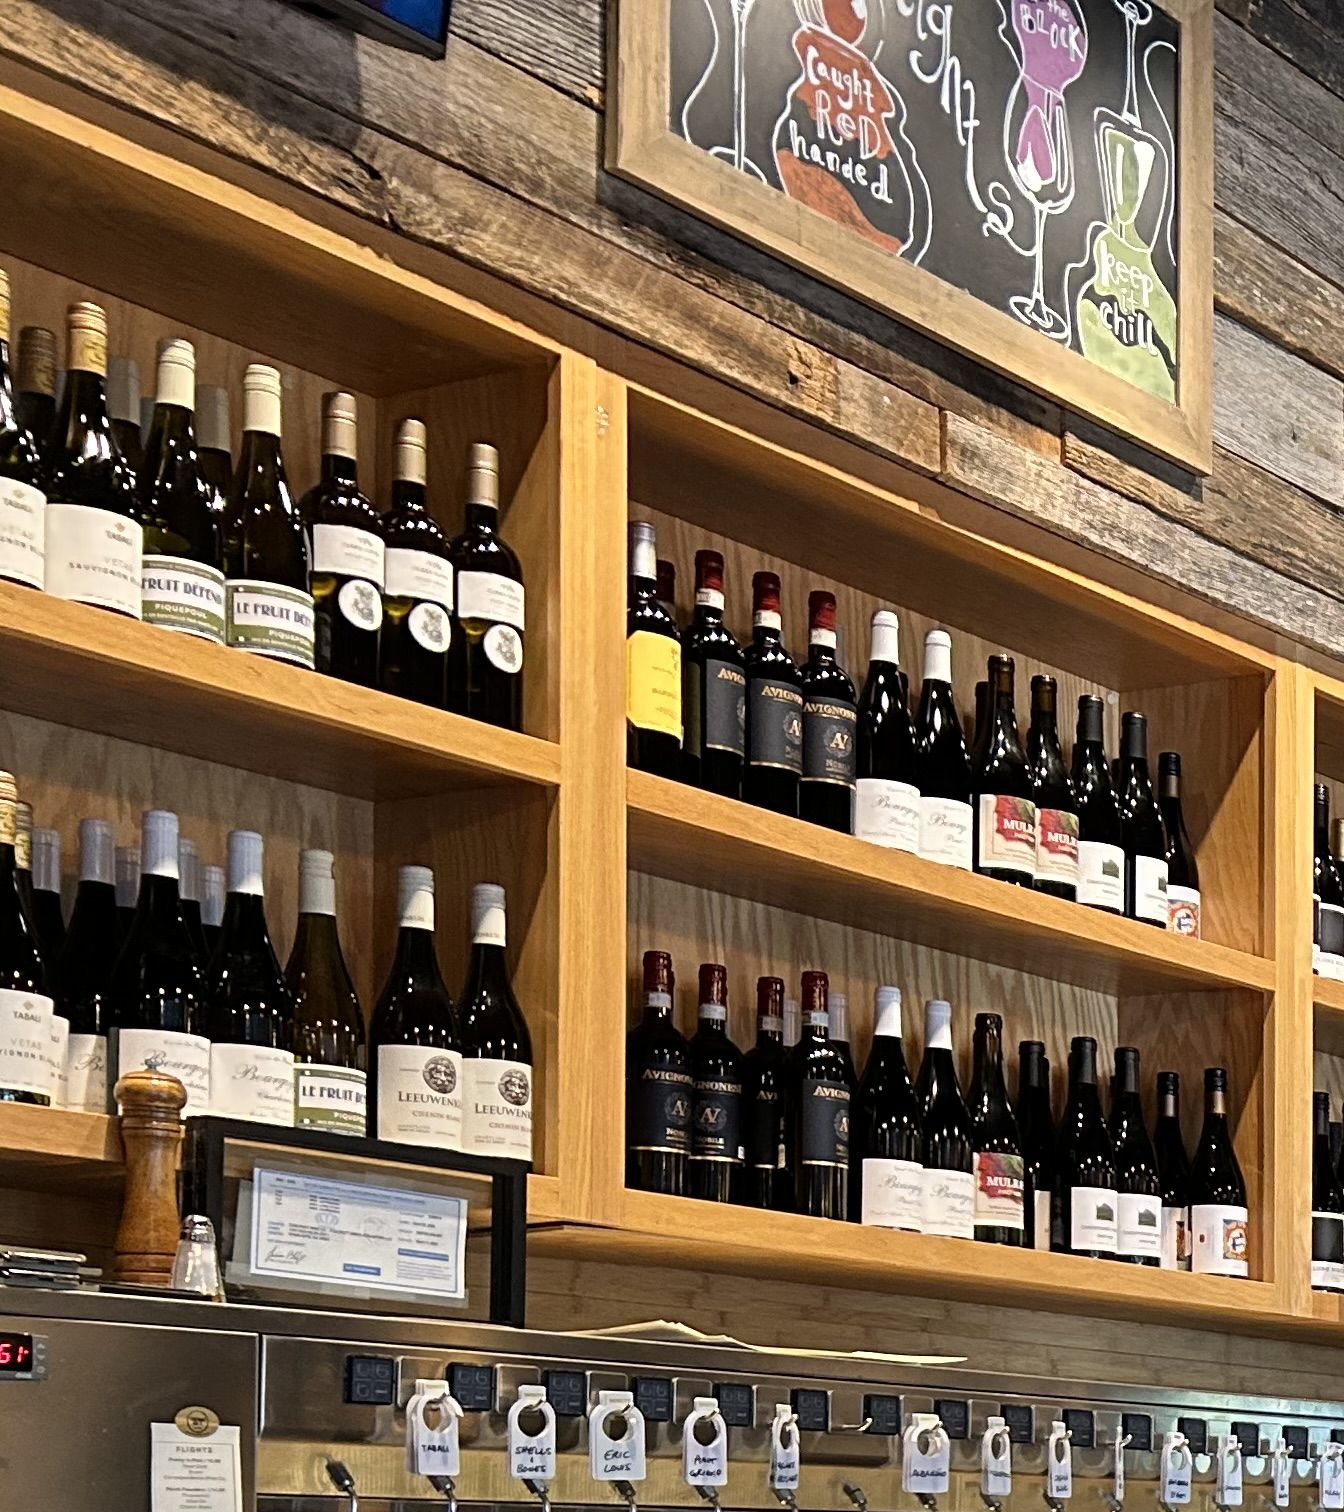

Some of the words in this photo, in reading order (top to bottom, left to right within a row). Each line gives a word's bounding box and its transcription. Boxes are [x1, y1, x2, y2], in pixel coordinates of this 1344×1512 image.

[789, 120, 893, 204] handed
[1121, 288, 1138, 316] it
[154, 602, 208, 620] PIQUEPOUL
[302, 1085, 316, 1097] LE
[319, 1087, 353, 1100] FRUIT
[603, 1450, 630, 1460] ERIC
